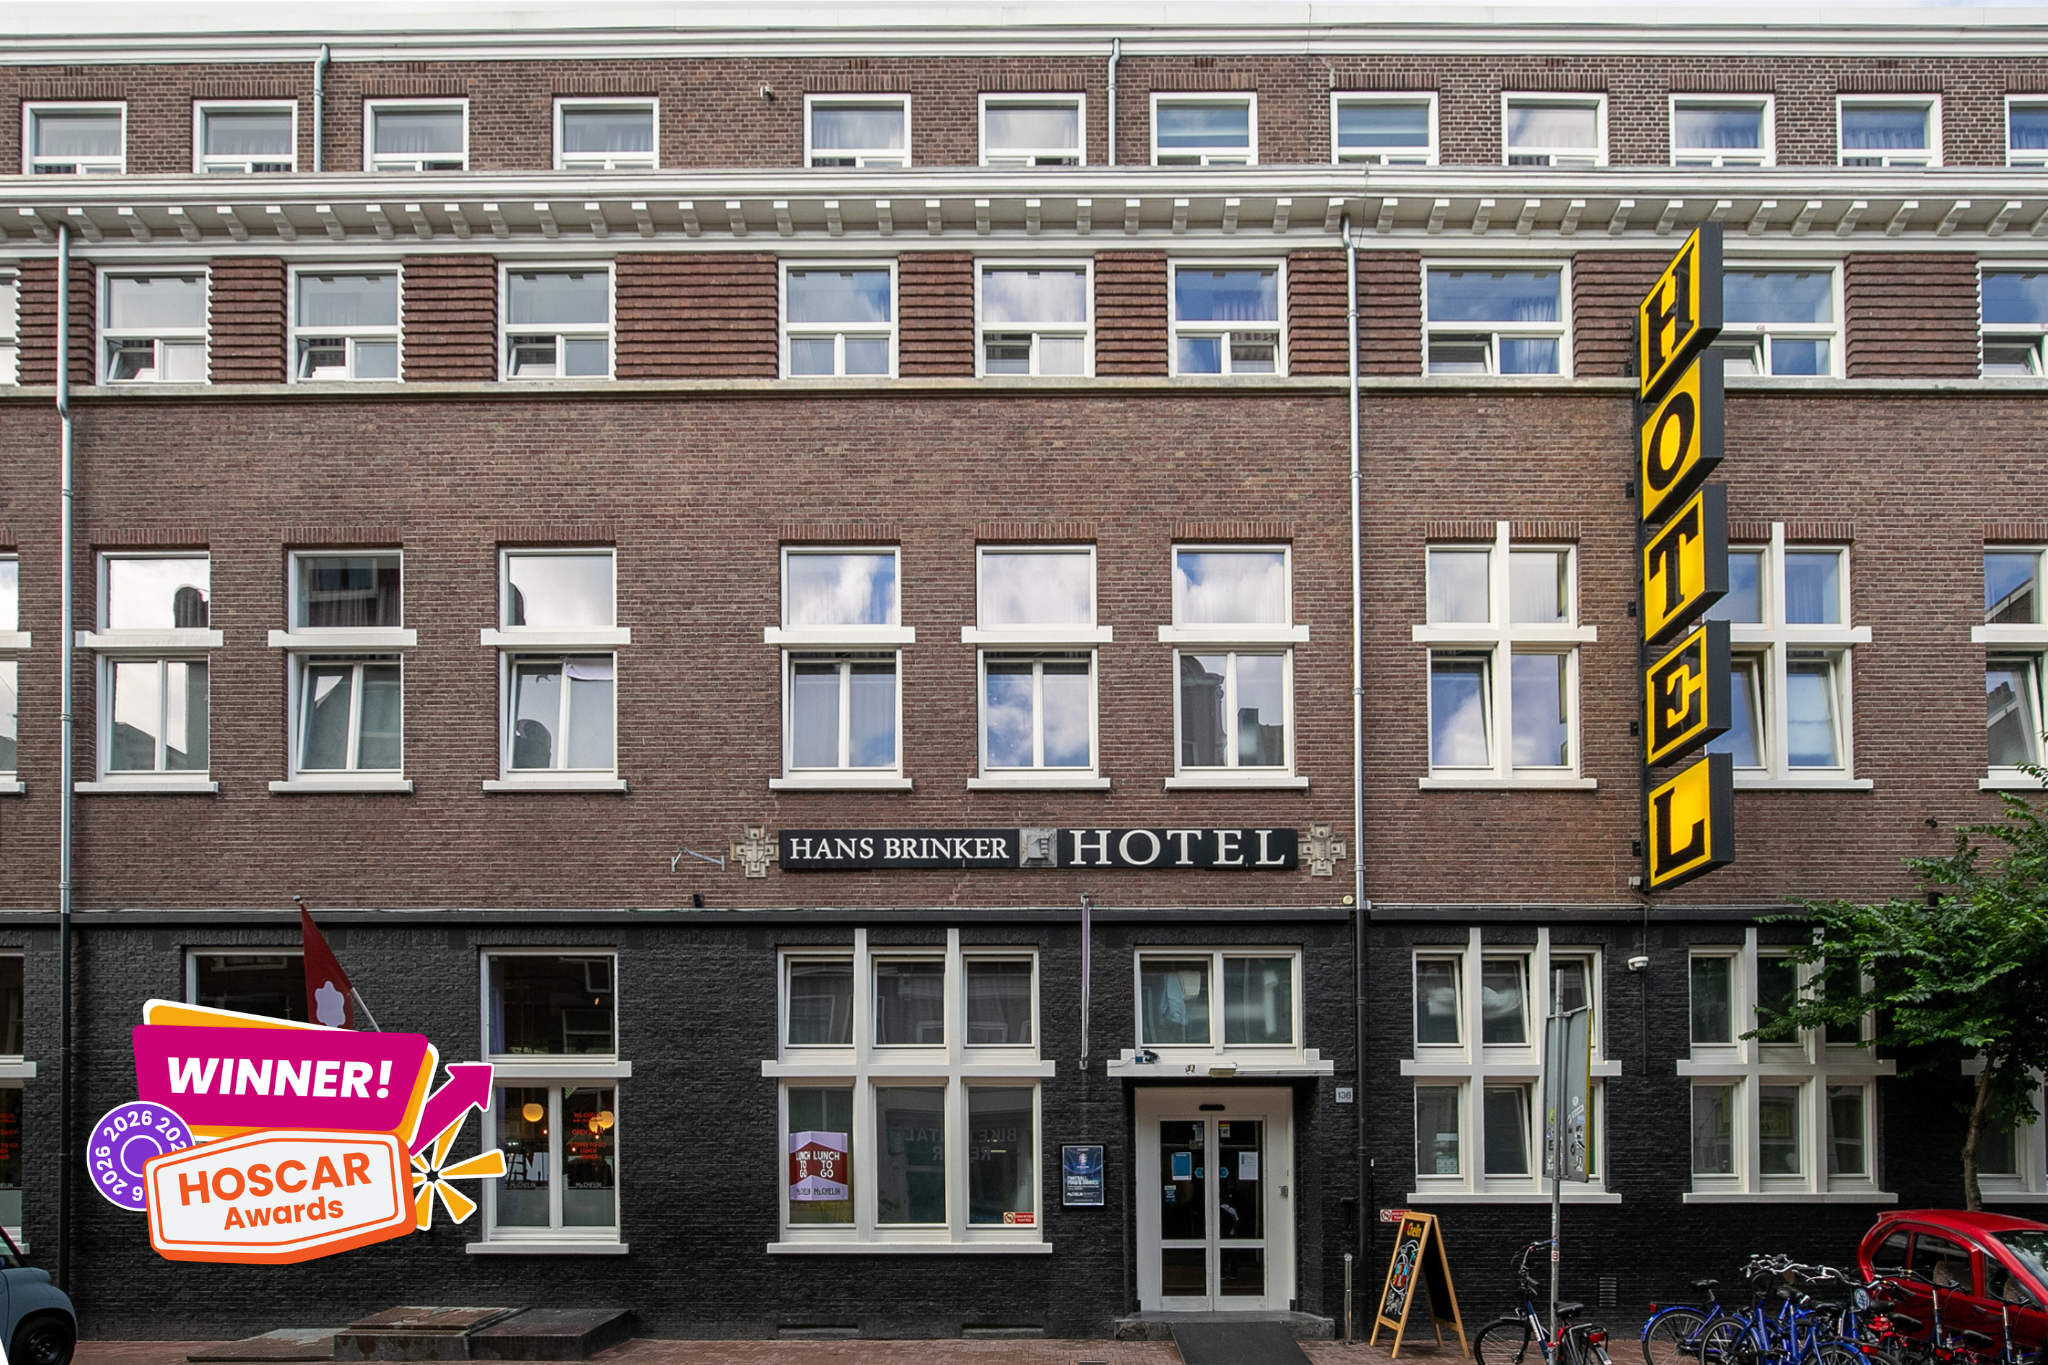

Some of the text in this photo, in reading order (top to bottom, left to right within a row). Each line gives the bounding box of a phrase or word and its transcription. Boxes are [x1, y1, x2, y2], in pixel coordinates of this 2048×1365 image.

[1644, 241, 1706, 878] HOTEL
[789, 829, 1286, 865] HANS BRINKER HOTEL
[813, 1151, 841, 1160] LUNCH
[821, 1160, 833, 1169] TO
[820, 1169, 834, 1178] GO
